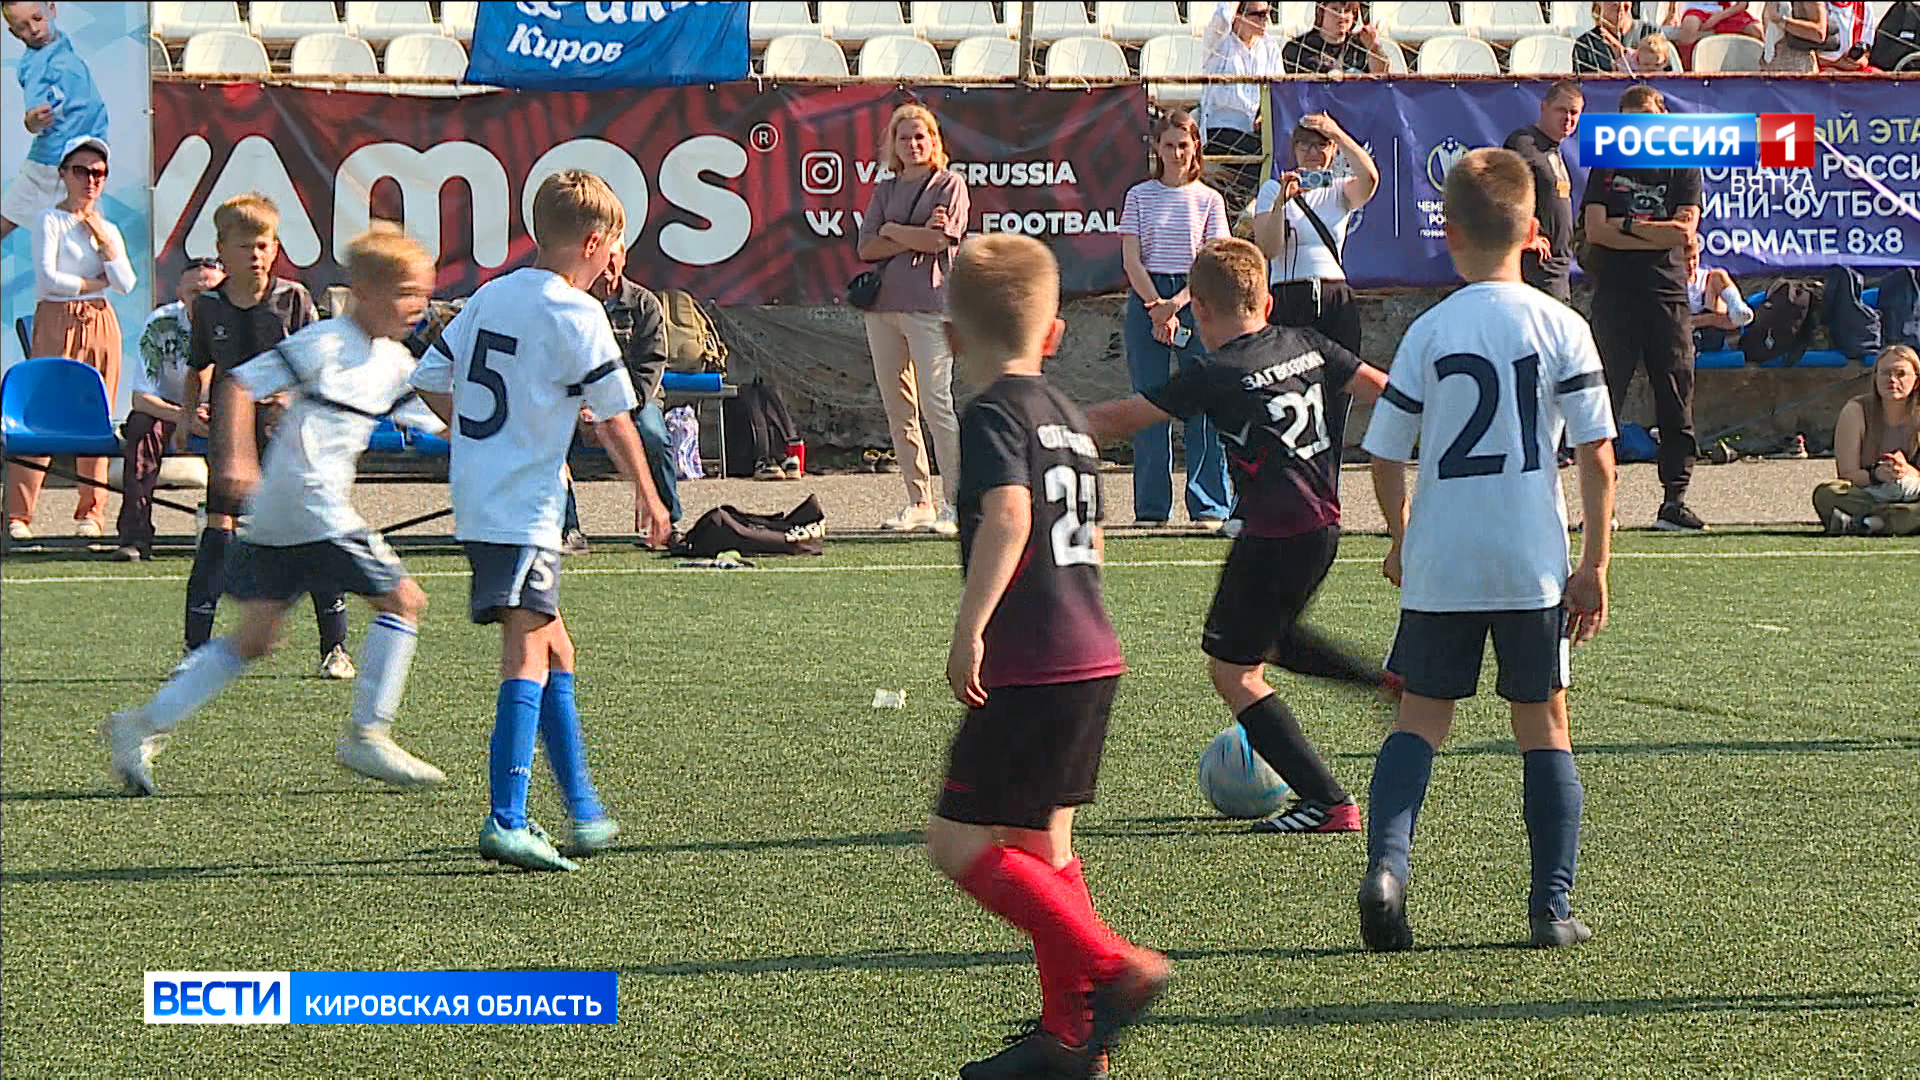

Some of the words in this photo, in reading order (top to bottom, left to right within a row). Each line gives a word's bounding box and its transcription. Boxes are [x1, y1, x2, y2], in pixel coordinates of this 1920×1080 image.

[507, 23, 624, 69] Киров
[855, 160, 1078, 186] VASRUSSIA
[1701, 190, 1920, 219] ИНИ-ФУТБОЛ
[459, 330, 517, 440] 5
[1266, 383, 1331, 460] 21
[1435, 353, 1541, 480] 21
[529, 550, 556, 591] 5
